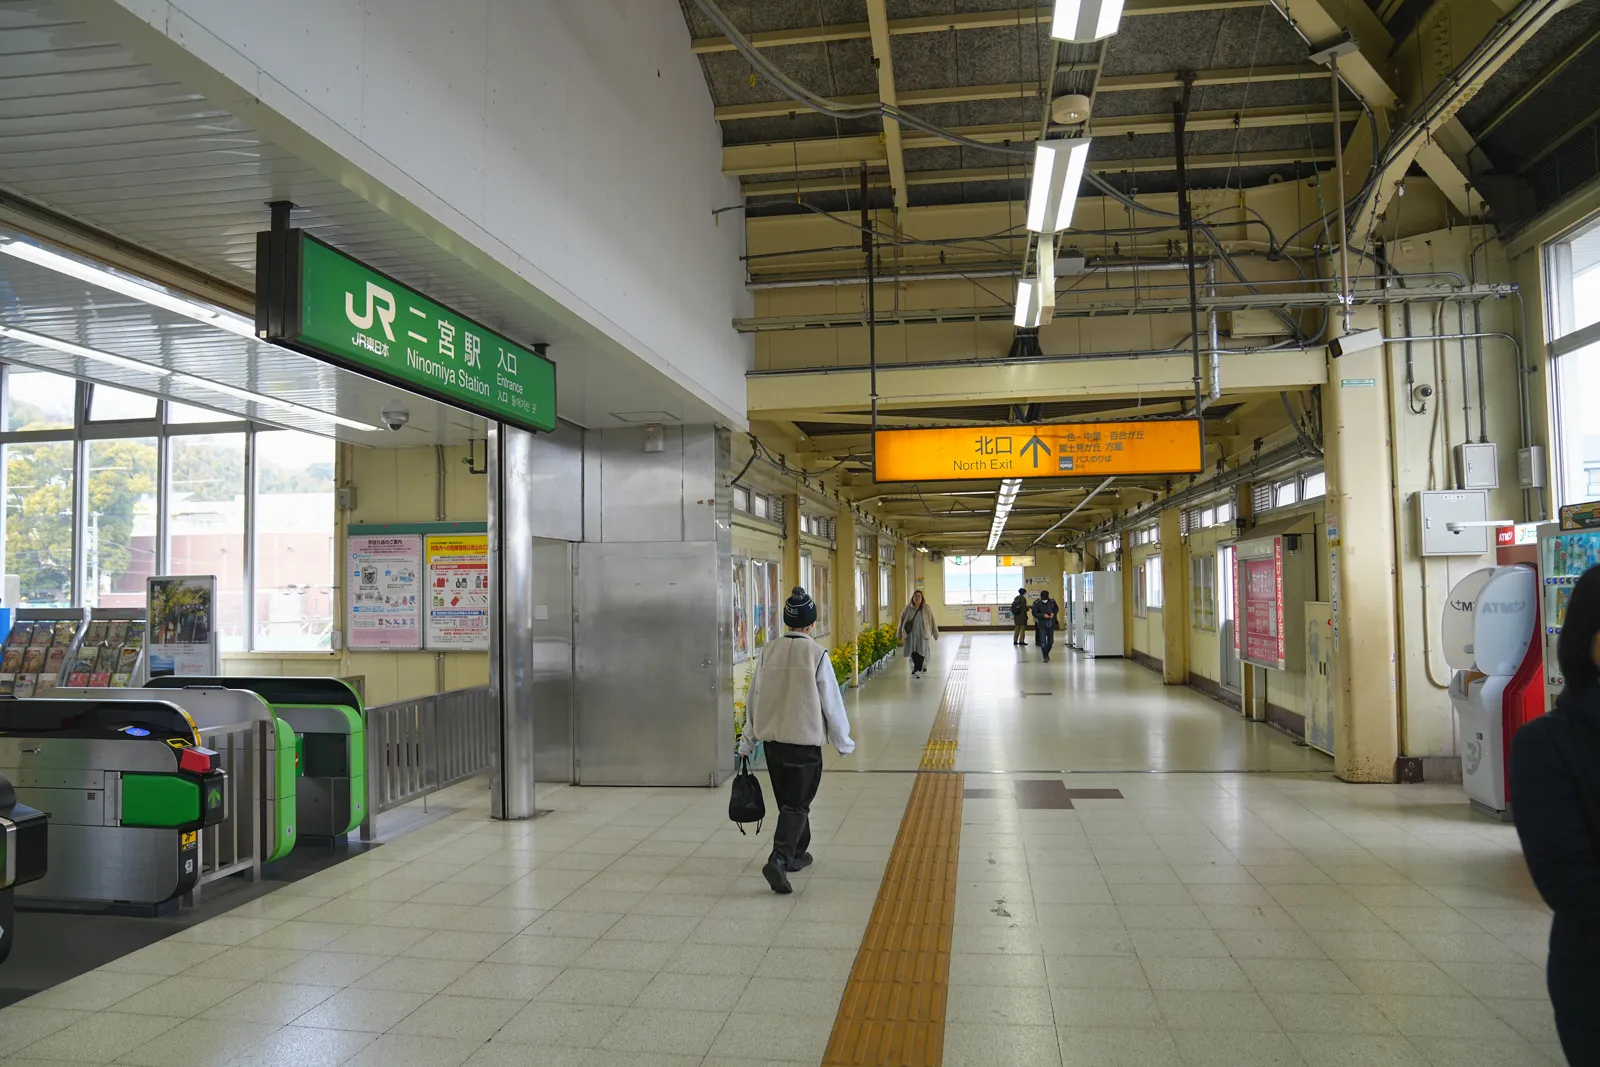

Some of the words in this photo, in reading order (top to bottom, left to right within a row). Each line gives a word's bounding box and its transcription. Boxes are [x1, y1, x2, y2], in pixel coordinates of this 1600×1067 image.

[345, 281, 396, 343] JR
[351, 332, 390, 357] JR東日本
[407, 306, 481, 370] 二宮駅
[407, 347, 456, 385] Ninomiya
[458, 368, 490, 397] Station
[497, 347, 517, 376] 入口
[496, 372, 523, 395] Entrance
[497, 390, 508, 403] 入口
[975, 435, 1012, 455] 北口
[1058, 443, 1102, 453] 富士見が丘
[953, 459, 987, 471] North
[990, 458, 1013, 470] Exit
[1075, 455, 1112, 463] バスのりば
[1482, 602, 1517, 614] ATM
